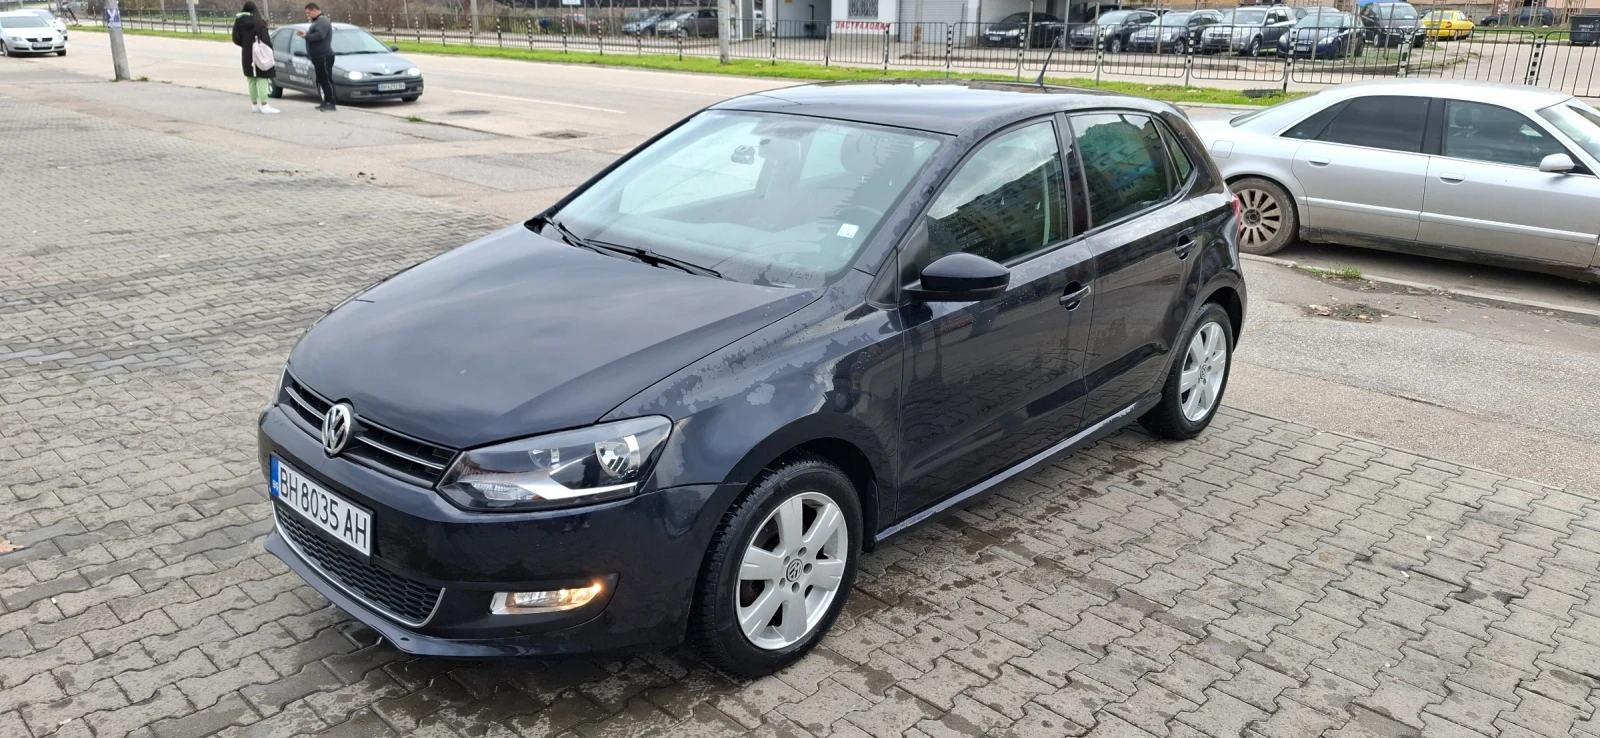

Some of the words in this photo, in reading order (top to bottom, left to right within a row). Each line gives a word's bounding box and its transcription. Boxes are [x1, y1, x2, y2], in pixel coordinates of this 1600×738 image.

[280, 466, 298, 506] BH
[301, 482, 339, 531] 8035
[343, 508, 367, 549] AH
